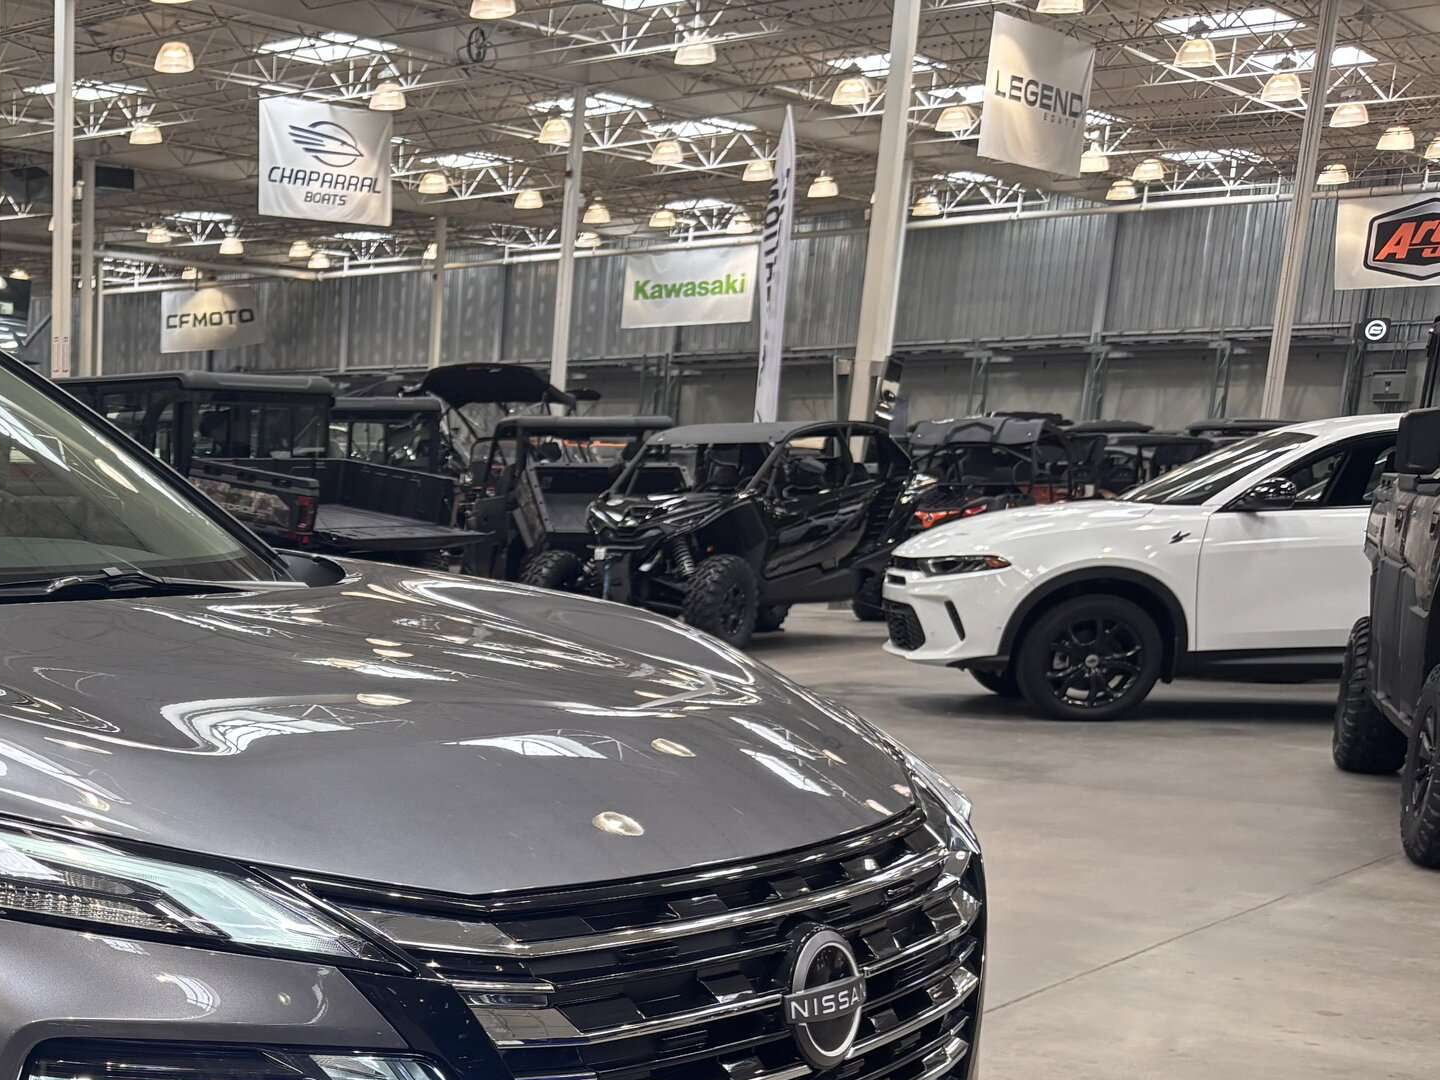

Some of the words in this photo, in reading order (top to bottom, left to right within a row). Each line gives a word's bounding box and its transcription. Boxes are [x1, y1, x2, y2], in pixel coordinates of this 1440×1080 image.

[994, 69, 1084, 118] LEGEND
[268, 166, 382, 194] CHAPARRAL
[304, 191, 348, 206] BOATS
[633, 273, 746, 300] Kawasaki
[166, 308, 254, 329] CFMOTO
